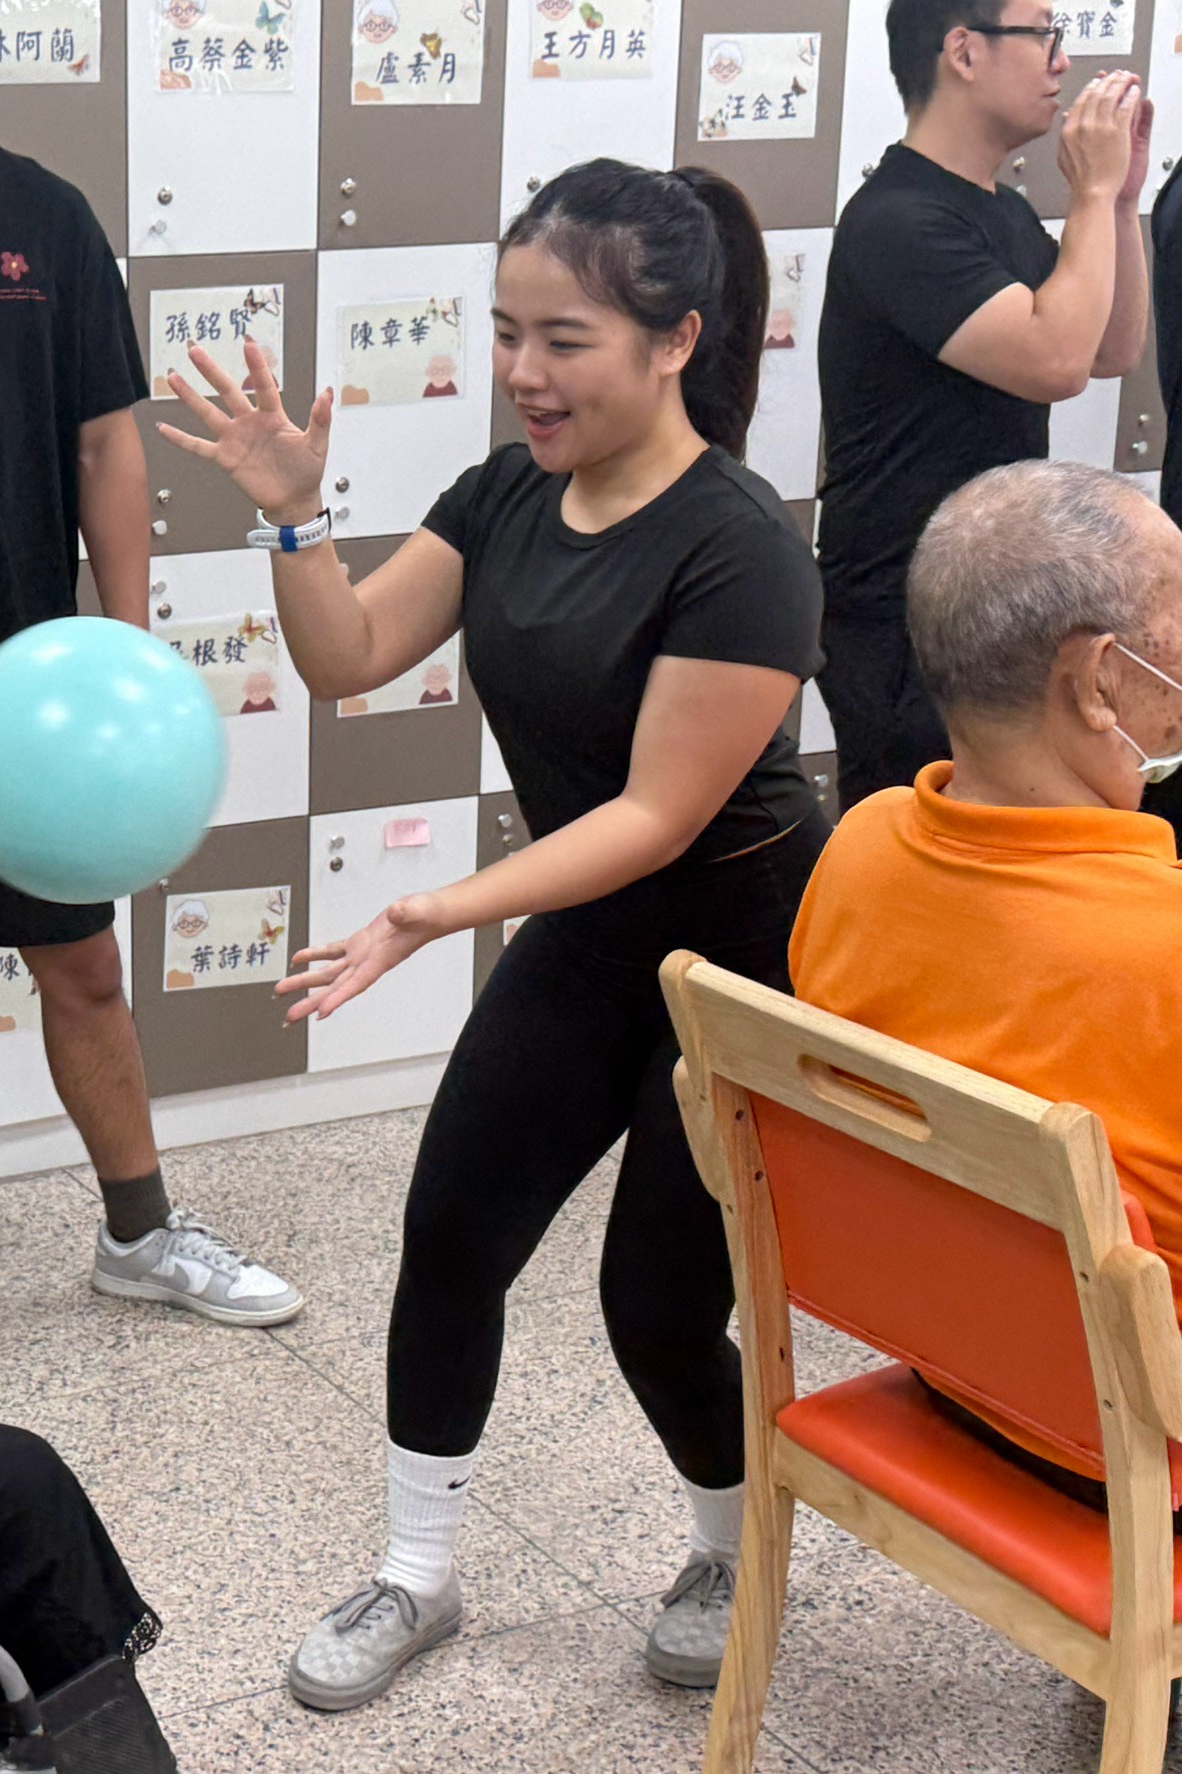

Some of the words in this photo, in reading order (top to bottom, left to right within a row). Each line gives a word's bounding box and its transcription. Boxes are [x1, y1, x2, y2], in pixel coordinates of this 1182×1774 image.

[168, 37, 289, 72] 高蔡金紫
[541, 29, 646, 60] 王方月英
[375, 51, 456, 84] 盧素月
[724, 92, 797, 121] 汪金玉
[165, 307, 252, 343] 孫銘賢
[350, 315, 430, 350] 陳章華
[169, 635, 249, 667] 根發
[190, 941, 271, 973] 葉詩軒
